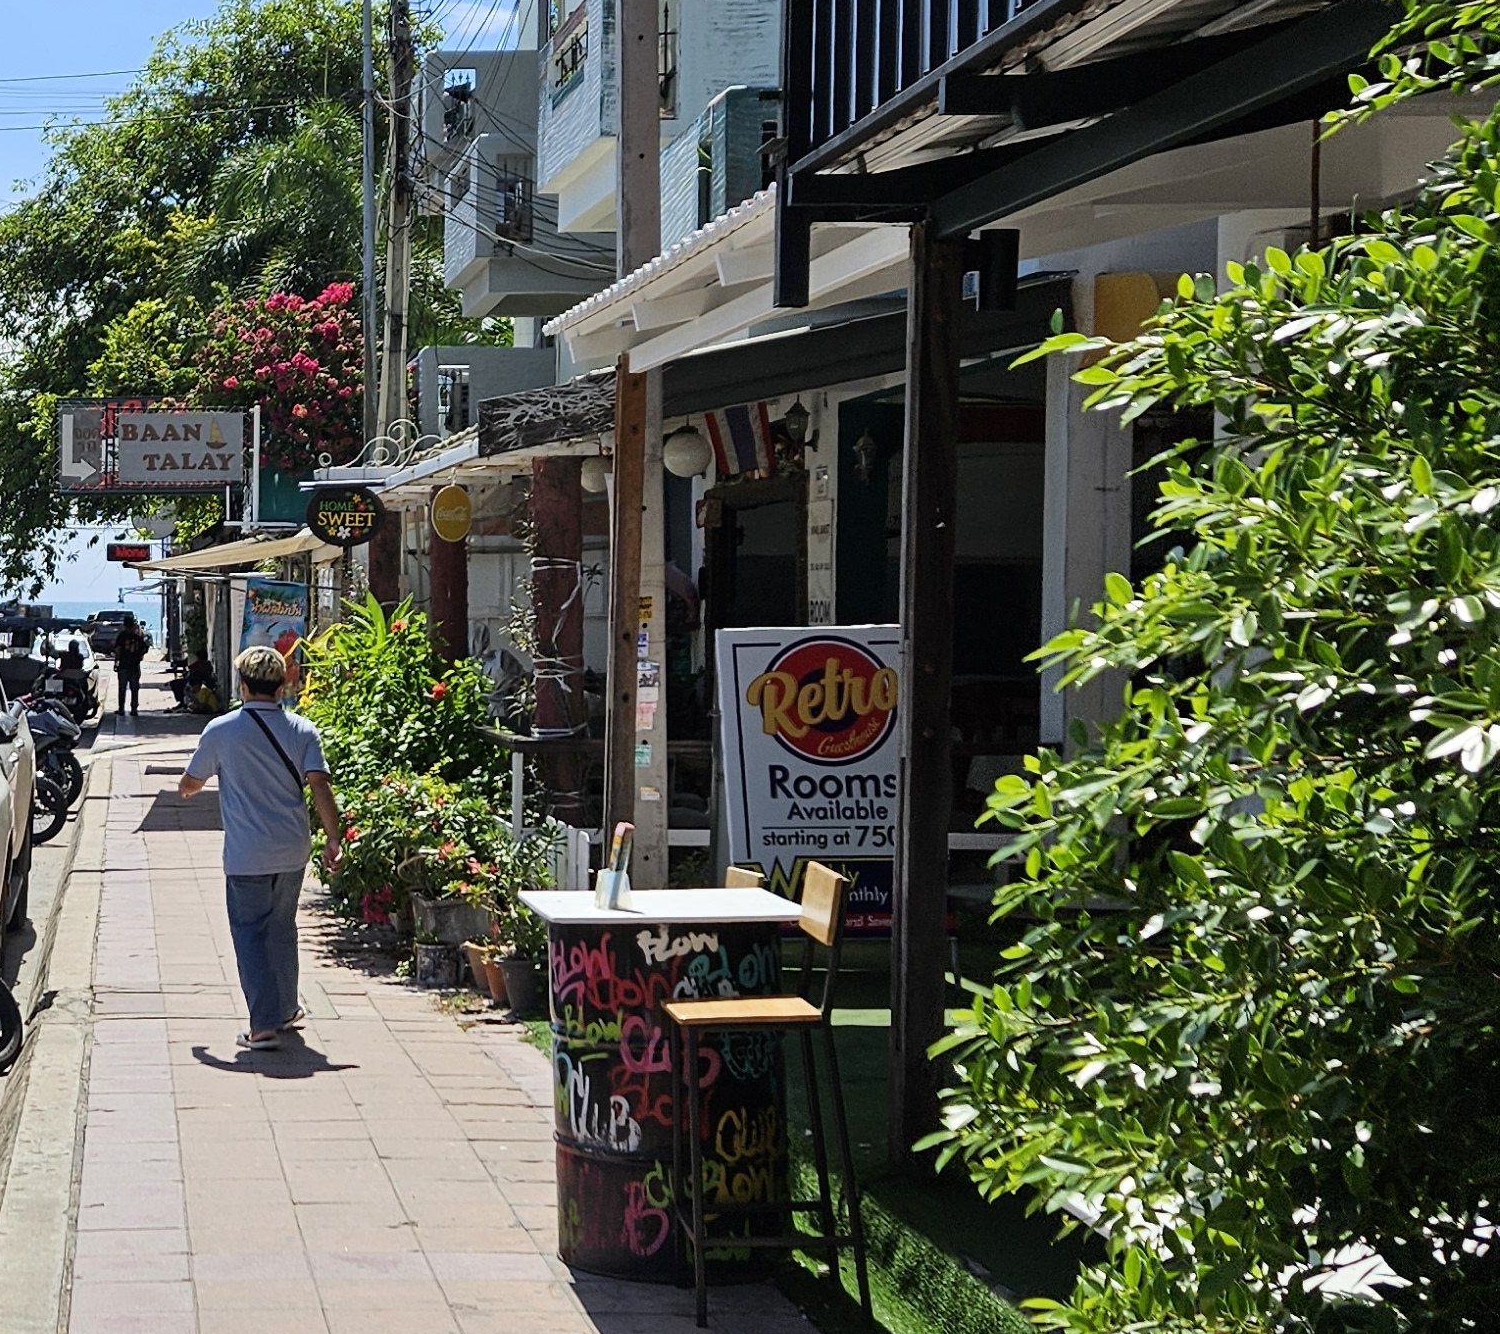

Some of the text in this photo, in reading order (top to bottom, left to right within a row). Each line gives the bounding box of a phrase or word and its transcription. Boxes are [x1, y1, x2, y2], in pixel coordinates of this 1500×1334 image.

[121, 423, 203, 442] BAAN
[143, 452, 235, 471] TALAY
[319, 500, 355, 511] HOME
[317, 511, 376, 527] SWEET
[746, 657, 898, 738] Retro
[768, 764, 897, 799] Rooms
[787, 800, 889, 820] Available
[762, 830, 828, 849] starting
[833, 830, 851, 846] at
[849, 886, 889, 905] nthly
